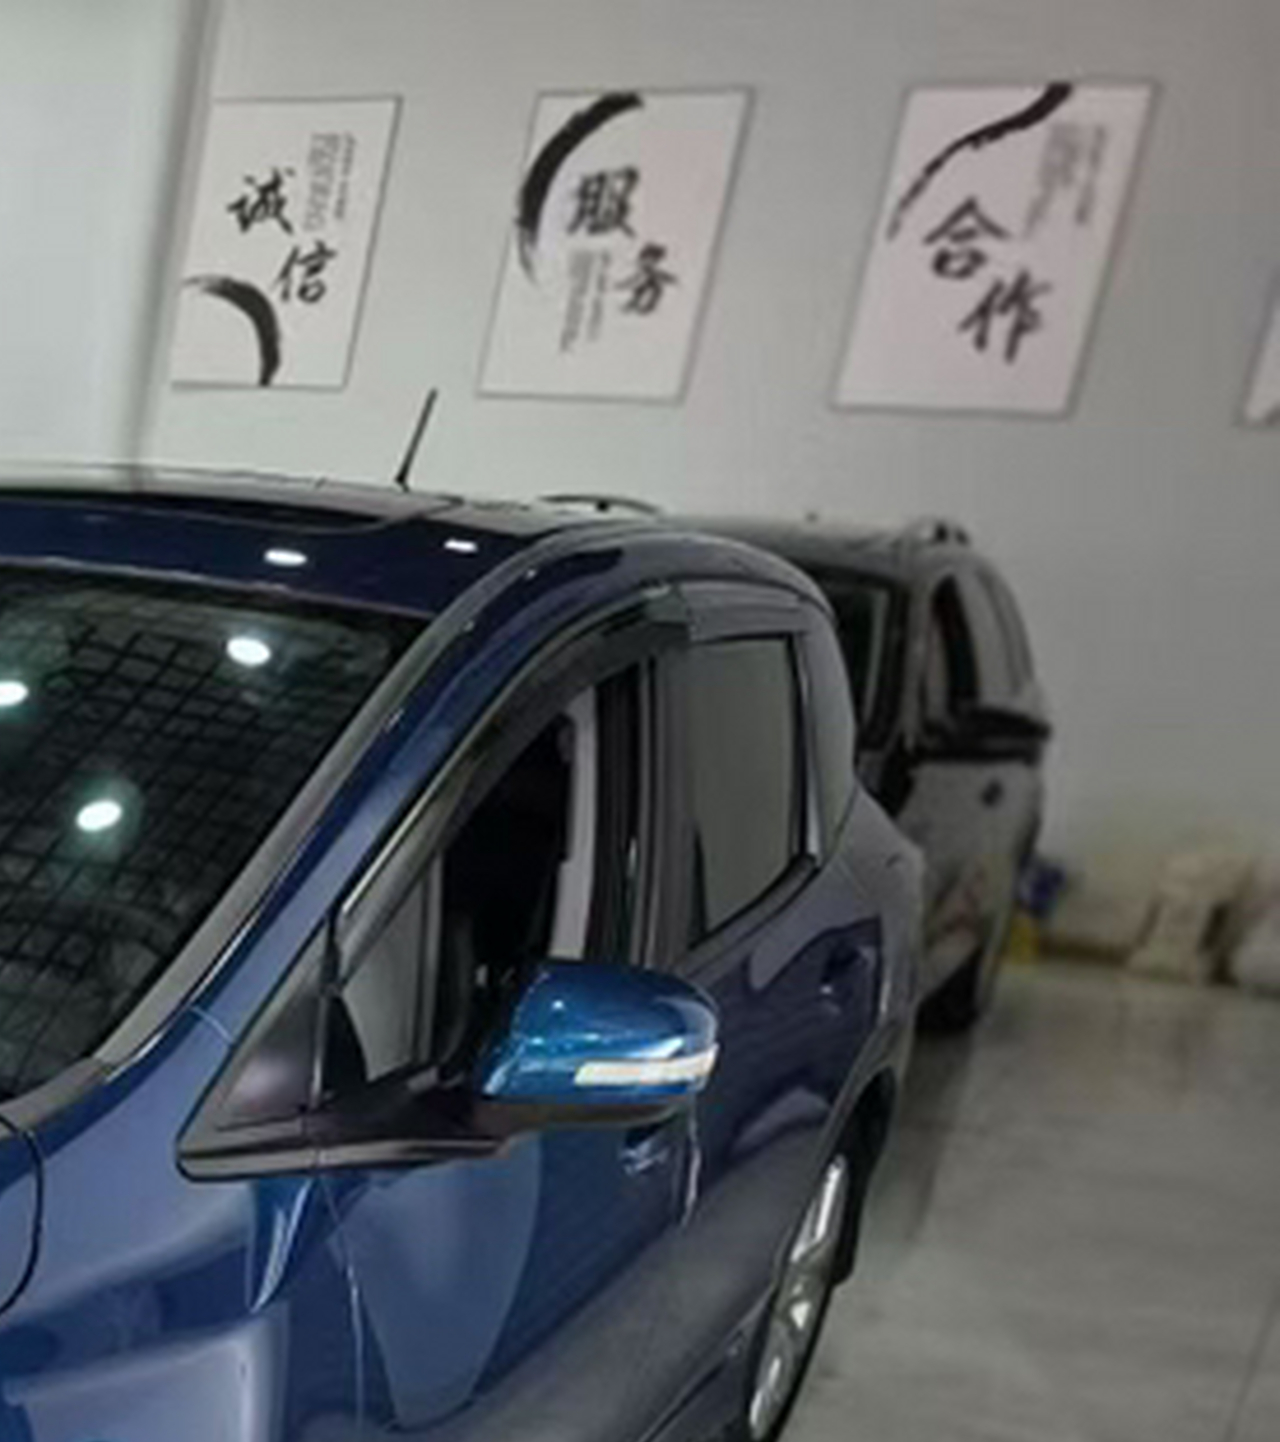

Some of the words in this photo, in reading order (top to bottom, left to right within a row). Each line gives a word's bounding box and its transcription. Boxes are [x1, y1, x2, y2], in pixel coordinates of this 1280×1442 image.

[226, 166, 337, 304] 诚信
[566, 165, 679, 316] 服务
[924, 196, 1053, 364] 合作
